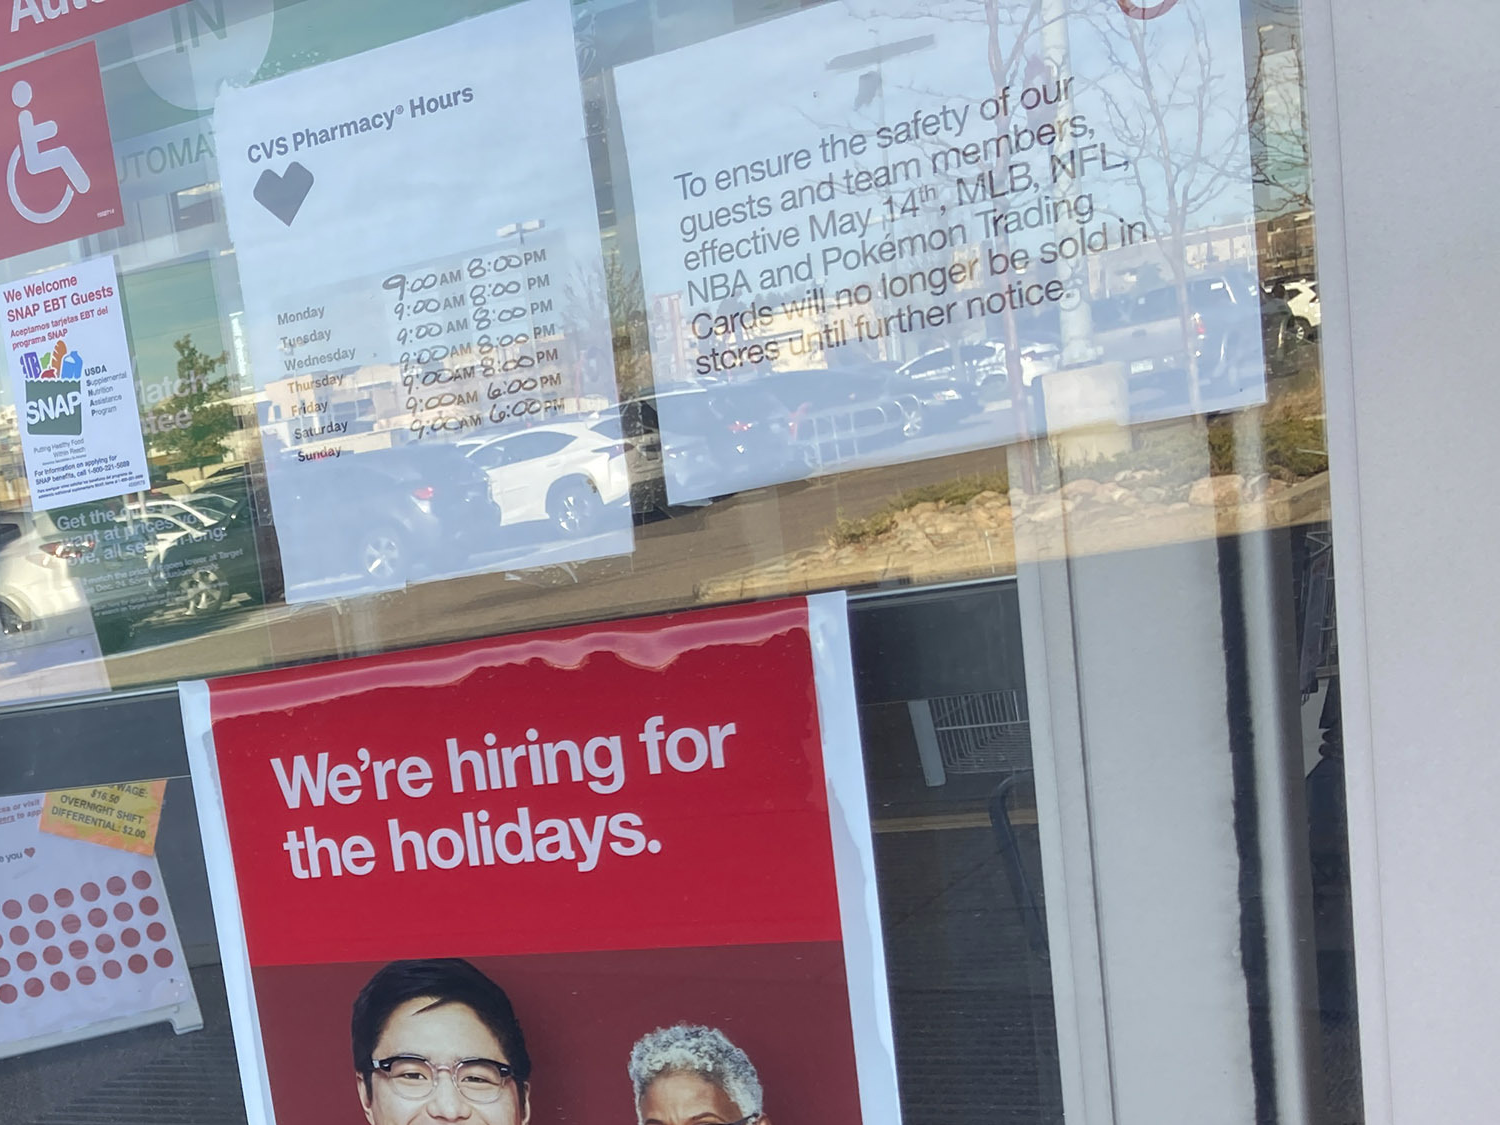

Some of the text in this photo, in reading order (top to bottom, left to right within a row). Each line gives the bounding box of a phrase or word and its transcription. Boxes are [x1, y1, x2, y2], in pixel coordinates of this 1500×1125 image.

[247, 136, 289, 163] CVS
[409, 87, 474, 118] Hours
[673, 76, 1075, 201] To ensure the safety of our
[680, 113, 1095, 243] guests and team members,
[683, 223, 800, 271] effective
[809, 207, 871, 242] May
[956, 160, 1040, 206] MLB,
[1051, 141, 1130, 184] NFL,
[687, 191, 1094, 306] NBA and Pokémon Trading
[3, 276, 78, 303] We Welcome
[277, 249, 547, 326] Monday 9:00 AM 8:00 PM
[691, 217, 1148, 340] Cards will no longer be sold in
[7, 285, 114, 323] SNAP EBT Guests
[10, 306, 108, 338] Aceptamos tarjetas EBT del
[280, 274, 550, 349] Tuesday 9:00 AM 8:00 PM
[12, 328, 68, 351] programa SNAP
[284, 299, 553, 372] Wednesday 9:00 AM 8:00 PM
[696, 278, 1072, 375] stores until further notice.
[84, 364, 107, 376] USDA
[287, 323, 556, 395] Thursday 9:00 AM 8:00 PM
[86, 371, 127, 386] Supplemental
[291, 348, 559, 417] Friday 9:00 AM 8:00 PM
[26, 391, 81, 425] SNAP
[91, 405, 117, 416] Program
[294, 373, 562, 440] Saturday 9:00 AM 6:00 PM
[297, 445, 342, 462] Sunday
[459, 414, 482, 431] AM
[489, 398, 542, 424] 6:00
[543, 397, 566, 413] PM
[34, 469, 43, 477] For
[108, 454, 117, 462] for
[35, 476, 51, 486] SNAP
[76, 469, 87, 477] call
[56, 515, 87, 531] Get
[89, 510, 115, 525] the
[104, 527, 120, 540] at
[104, 546, 121, 561] all
[218, 549, 244, 562] Target
[270, 715, 738, 810] We're hiring for
[60, 794, 144, 825] OVERNIGHT SHIFT
[90, 788, 120, 804] $16.50
[122, 825, 146, 839] $2.00
[282, 806, 662, 881] the holidays.
[5, 851, 23, 863] you
